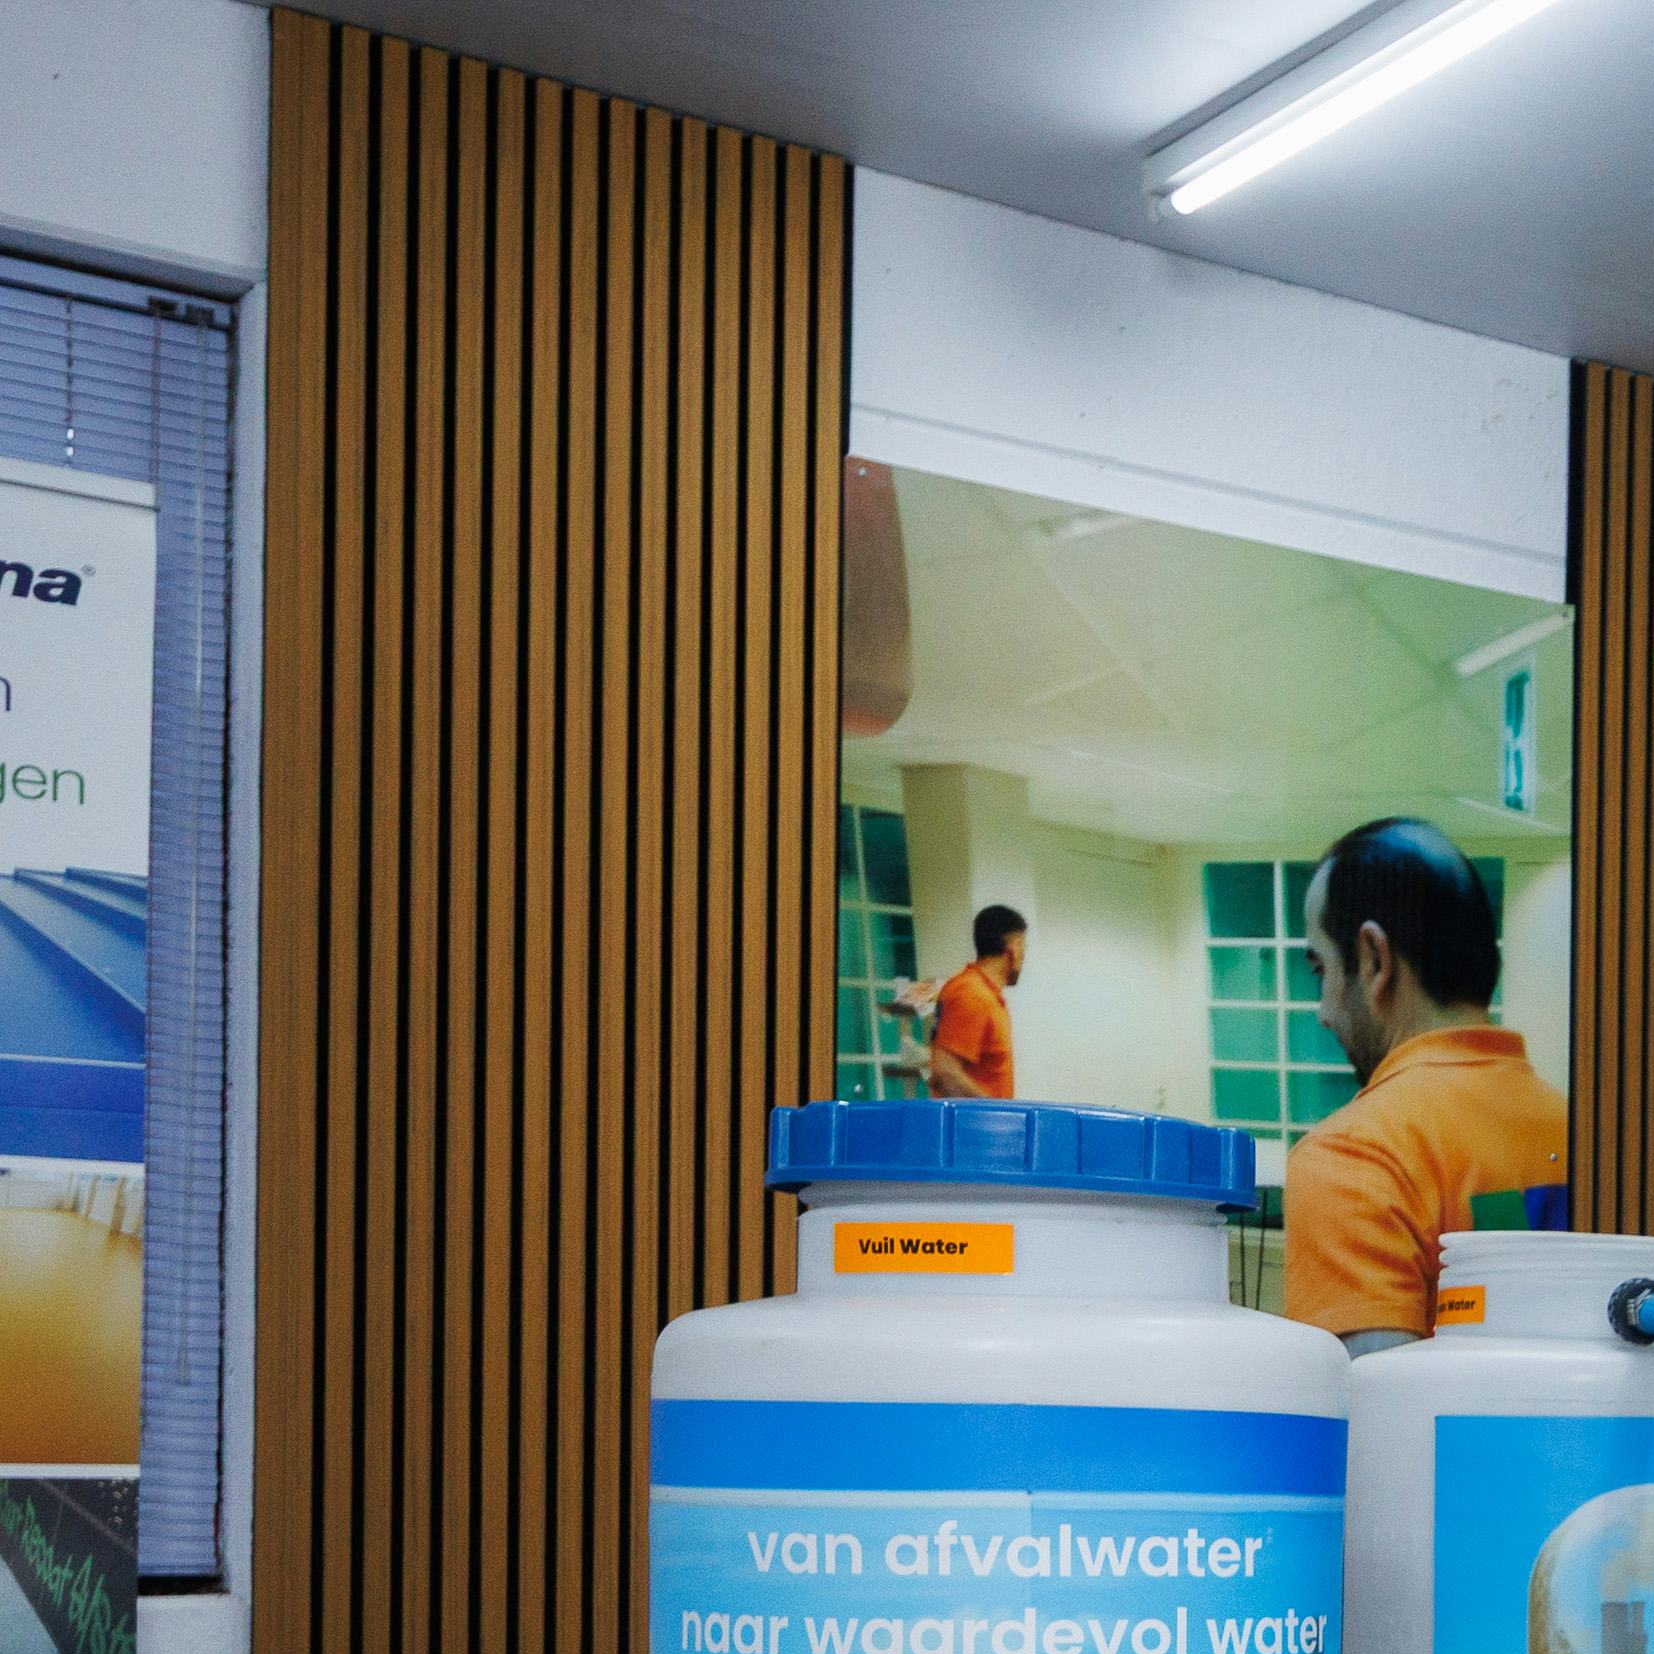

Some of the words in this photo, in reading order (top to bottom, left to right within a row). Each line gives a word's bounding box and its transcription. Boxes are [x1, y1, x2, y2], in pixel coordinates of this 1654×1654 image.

[859, 1236, 895, 1255] Vuil
[900, 1237, 968, 1255] Water
[748, 1529, 863, 1576] van
[885, 1519, 1262, 1578] afvalwater
